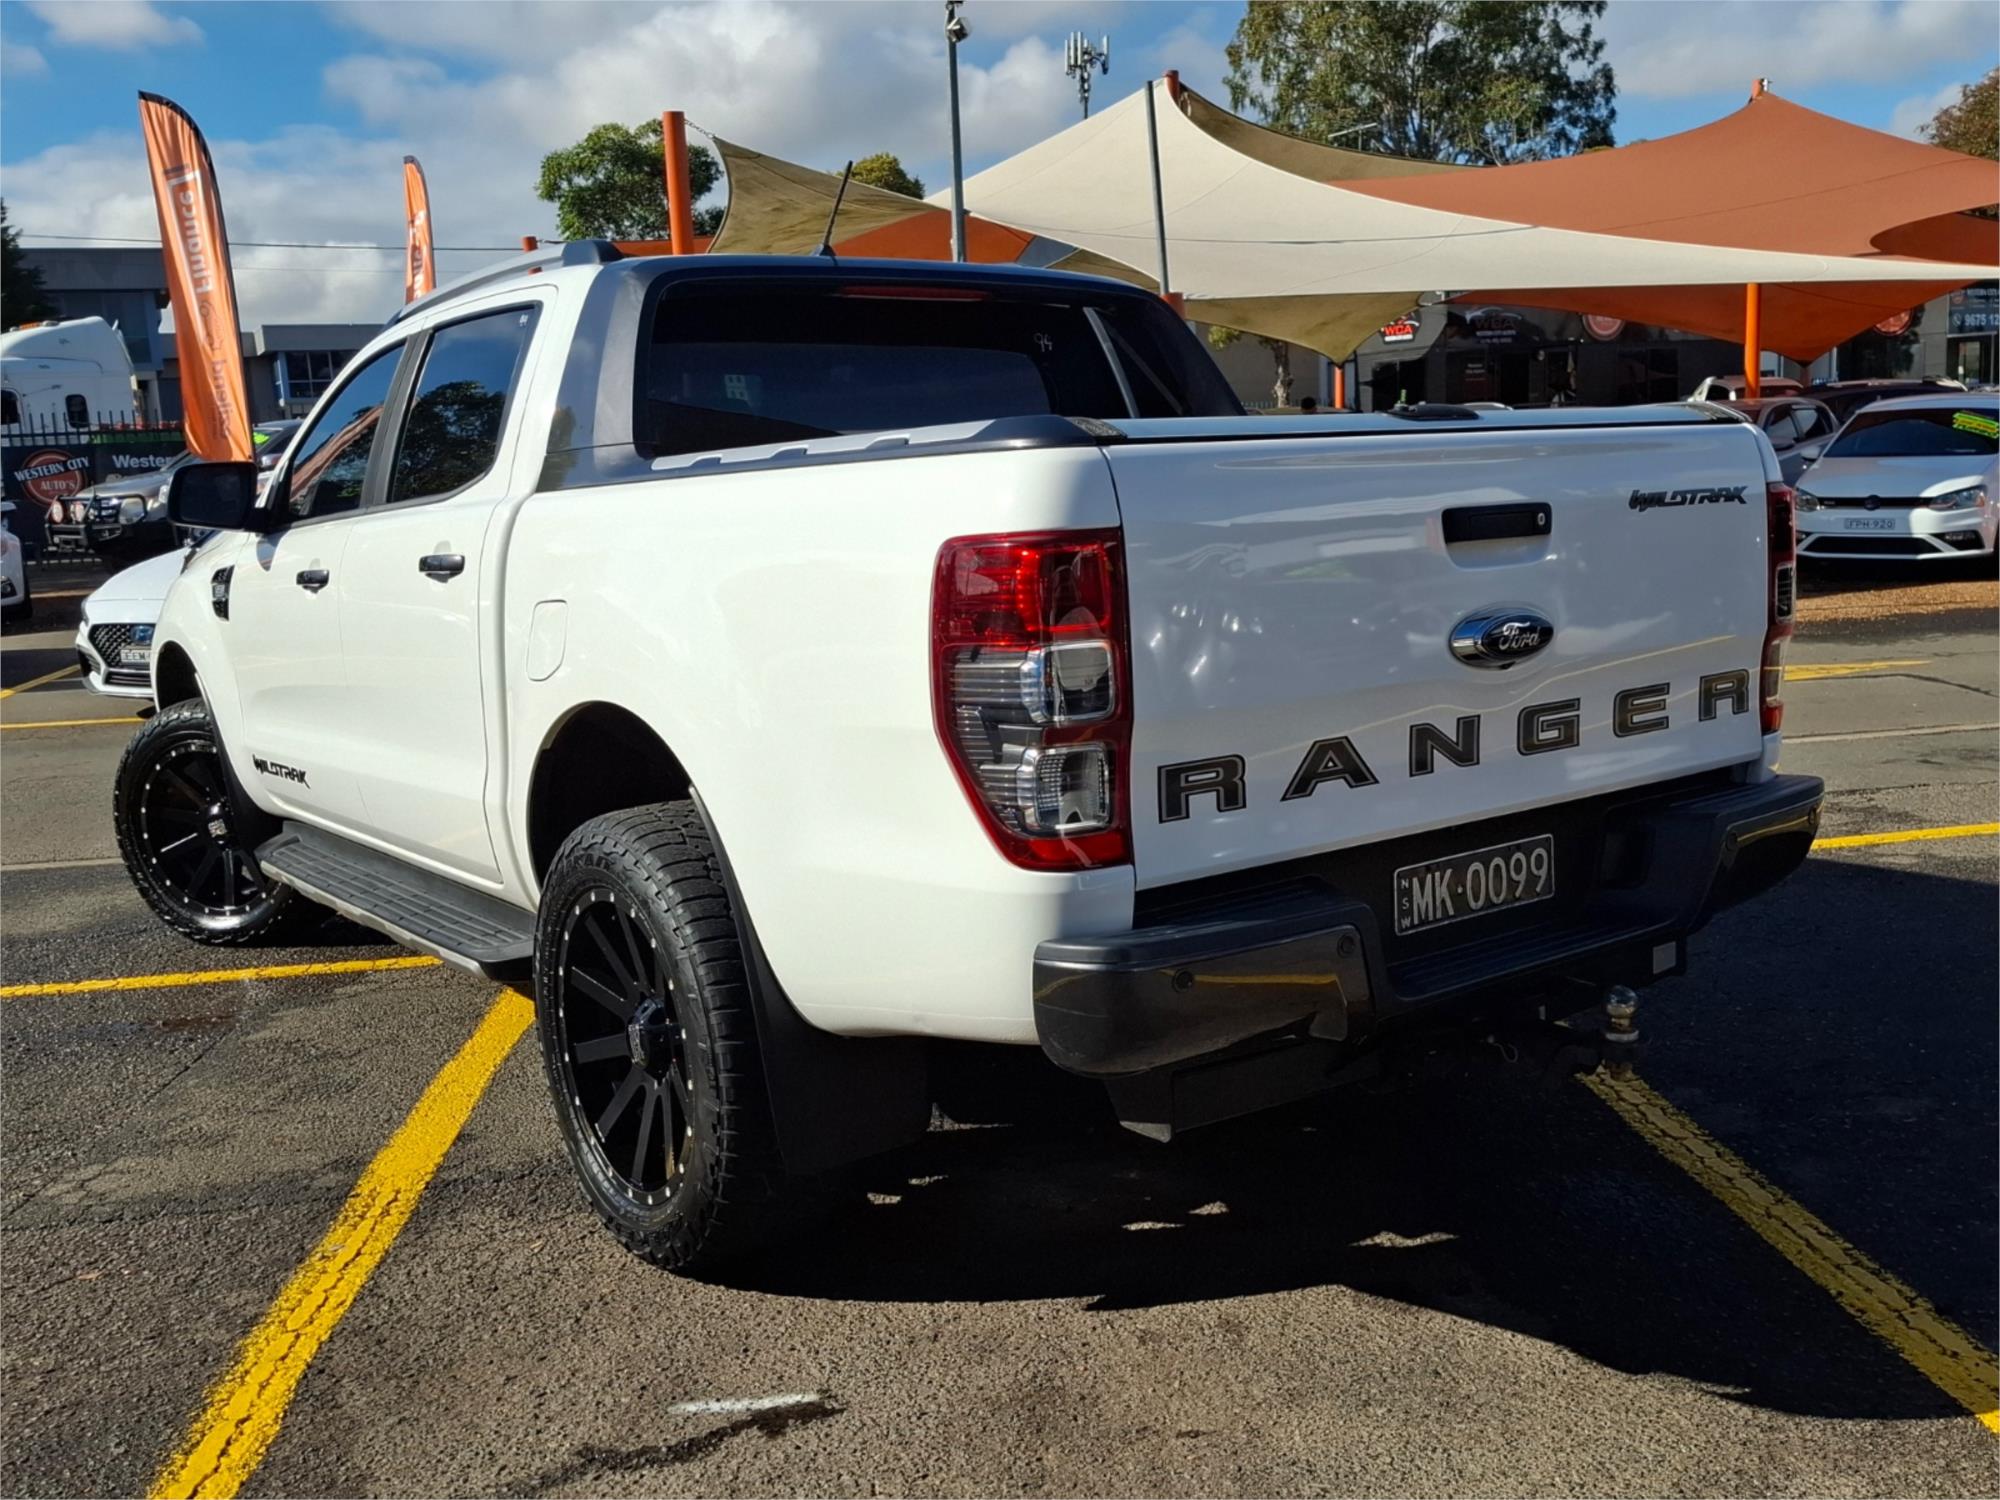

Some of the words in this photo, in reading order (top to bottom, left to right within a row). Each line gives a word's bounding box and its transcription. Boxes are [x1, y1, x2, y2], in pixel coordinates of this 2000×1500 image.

[14, 463, 65, 482] WESTERN
[67, 456, 90, 470] CITY
[40, 479, 75, 491] AUTO'S
[1629, 486, 1748, 512] WILDTRAK
[1499, 621, 1541, 651] Ford
[1158, 669, 1750, 824] RANGER
